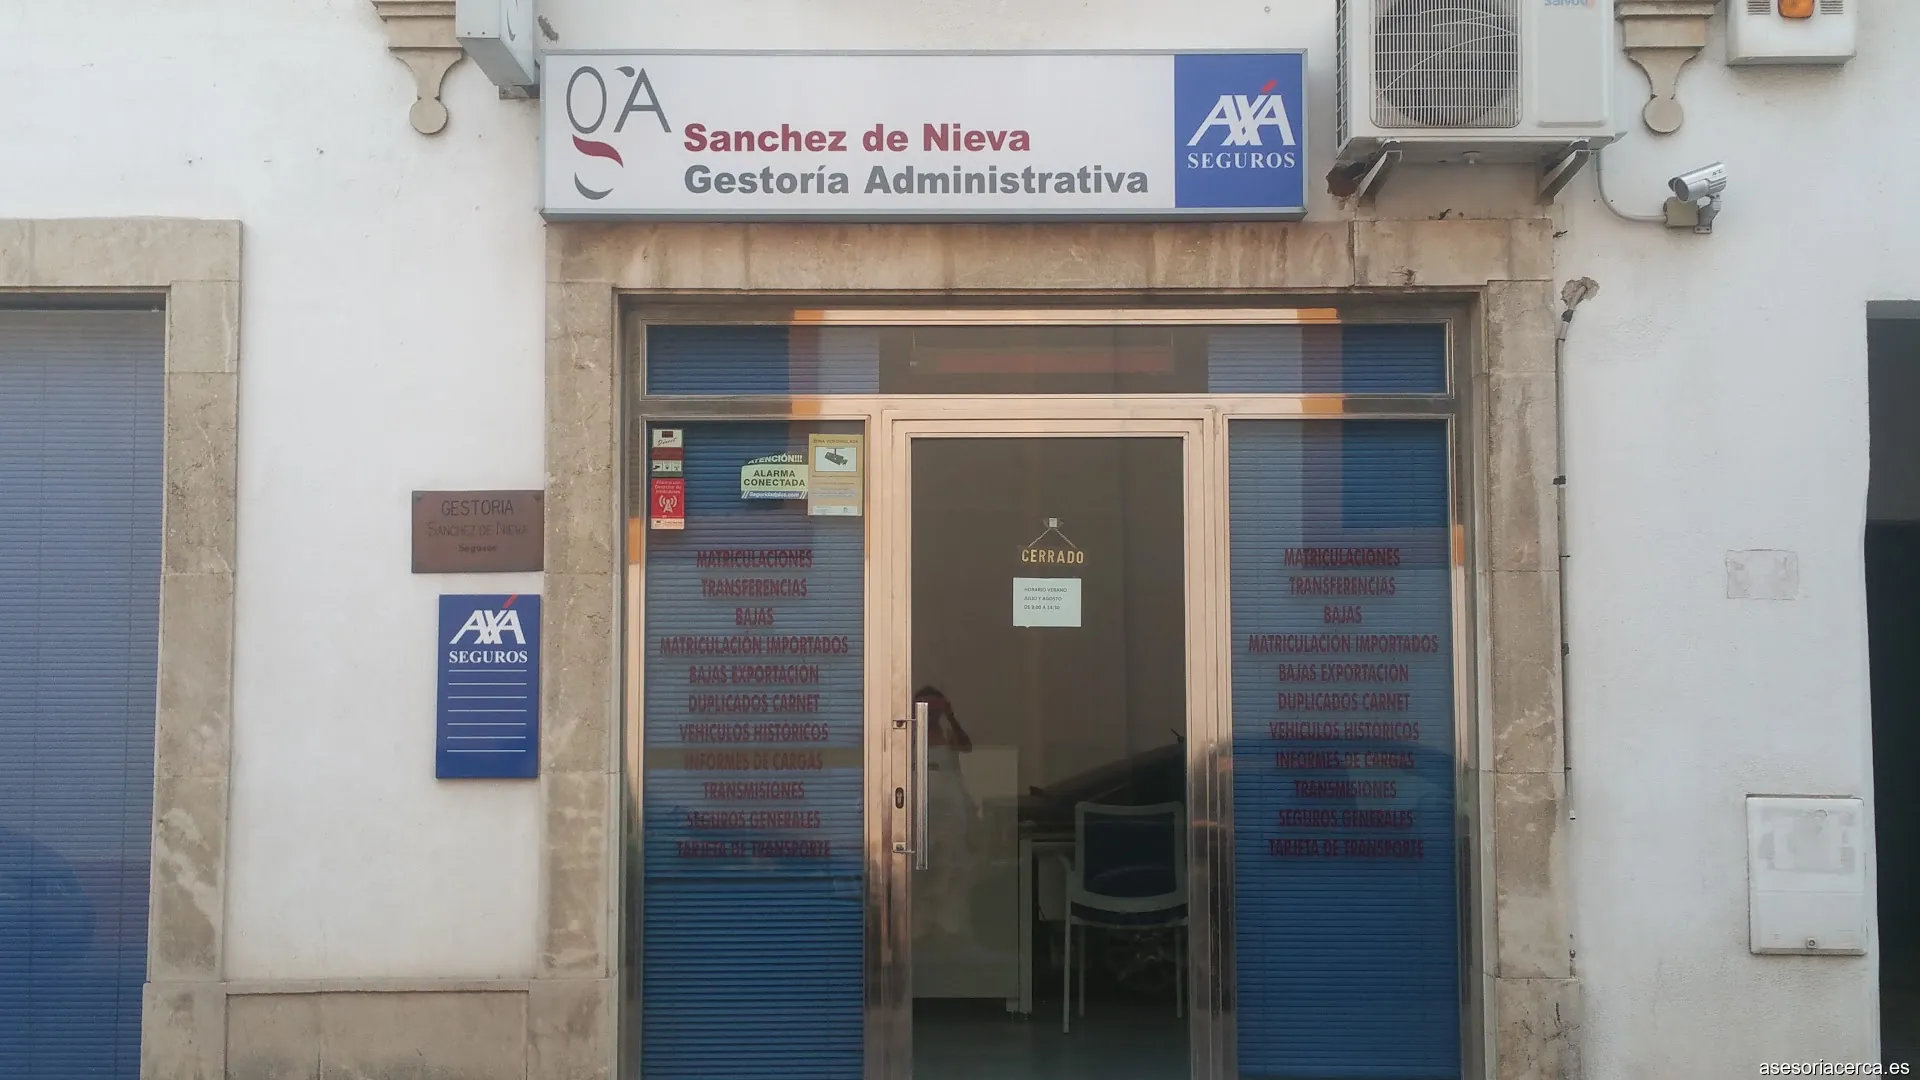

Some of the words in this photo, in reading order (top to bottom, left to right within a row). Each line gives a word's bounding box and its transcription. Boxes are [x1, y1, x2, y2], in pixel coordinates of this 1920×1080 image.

[1186, 80, 1297, 147] AXA
[684, 123, 847, 152] Sanchez
[863, 123, 909, 152] de
[923, 123, 1031, 152] Nieva
[1187, 151, 1296, 169] SEGUROS
[684, 165, 850, 194] Gestoría
[864, 165, 1149, 194] Administrativa
[743, 478, 806, 487] CONECTADA
[754, 469, 796, 478] ALARMA
[441, 499, 514, 516] GESTORIA
[696, 549, 813, 568] MATRICULACIONES
[1021, 549, 1084, 564] CERRADO
[1284, 548, 1400, 567] MATRICULACIONES
[702, 578, 808, 597] TRANSFERENCIAS
[1289, 576, 1396, 596] TRANSFERENCIAS
[449, 593, 526, 644] AXA
[735, 607, 774, 626] BAJAS
[1323, 605, 1363, 624] BAJAS
[766, 636, 848, 654] IMPORTADOS
[1249, 630, 1350, 654] MATRICULACIÓN
[1356, 634, 1439, 654] IMPORTADOS
[448, 650, 528, 664] SEGUROS
[689, 665, 727, 684] BAJAS
[1278, 663, 1316, 682] BAJAS
[688, 694, 768, 713] DUPLICADOS
[772, 694, 820, 712] CARNET
[1278, 692, 1358, 712] DUPLICADOS
[1362, 692, 1411, 711] CARNET
[684, 752, 749, 771] INFORMES
[754, 752, 769, 771] DE
[773, 752, 823, 771] CARGAS
[1276, 751, 1340, 769] INFORMES
[1344, 751, 1360, 769] DE
[1364, 751, 1415, 769] CARGAS
[704, 781, 805, 800] TRANSMISIONES
[1294, 780, 1396, 798] TRANSMISIONES
[687, 811, 745, 829] SEGUROS
[749, 810, 820, 829] GENERALES
[1279, 809, 1338, 827] SEGUROS
[1342, 809, 1414, 828] GENERALES
[677, 840, 728, 858] TARJETA
[730, 840, 747, 858] DE
[750, 839, 831, 858] TRANSPORTE
[1268, 838, 1319, 857] TARJETA
[1323, 838, 1340, 857] DE
[1344, 838, 1425, 858] TRANSPORTE
